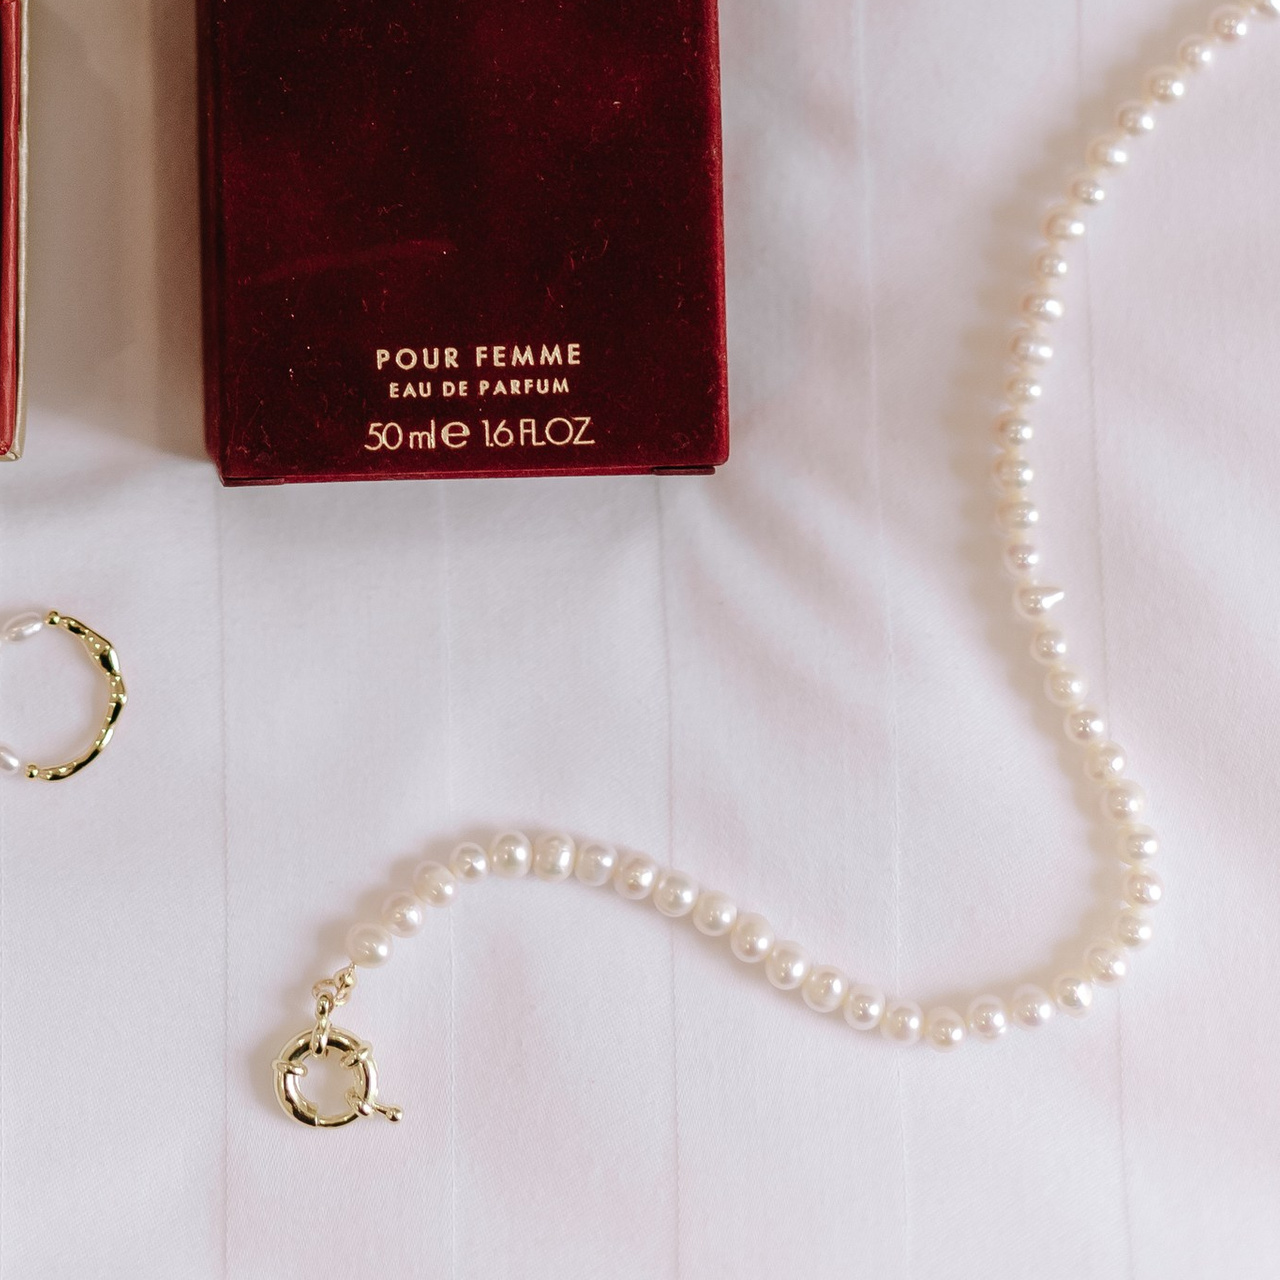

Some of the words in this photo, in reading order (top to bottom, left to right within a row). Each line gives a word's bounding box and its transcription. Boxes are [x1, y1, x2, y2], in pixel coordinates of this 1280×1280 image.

[376, 346, 460, 371] POUR
[475, 343, 581, 368] FEMME
[389, 380, 432, 399] EAU
[442, 380, 468, 398] DE
[478, 377, 570, 396] PARFUM
[363, 421, 404, 451] 50
